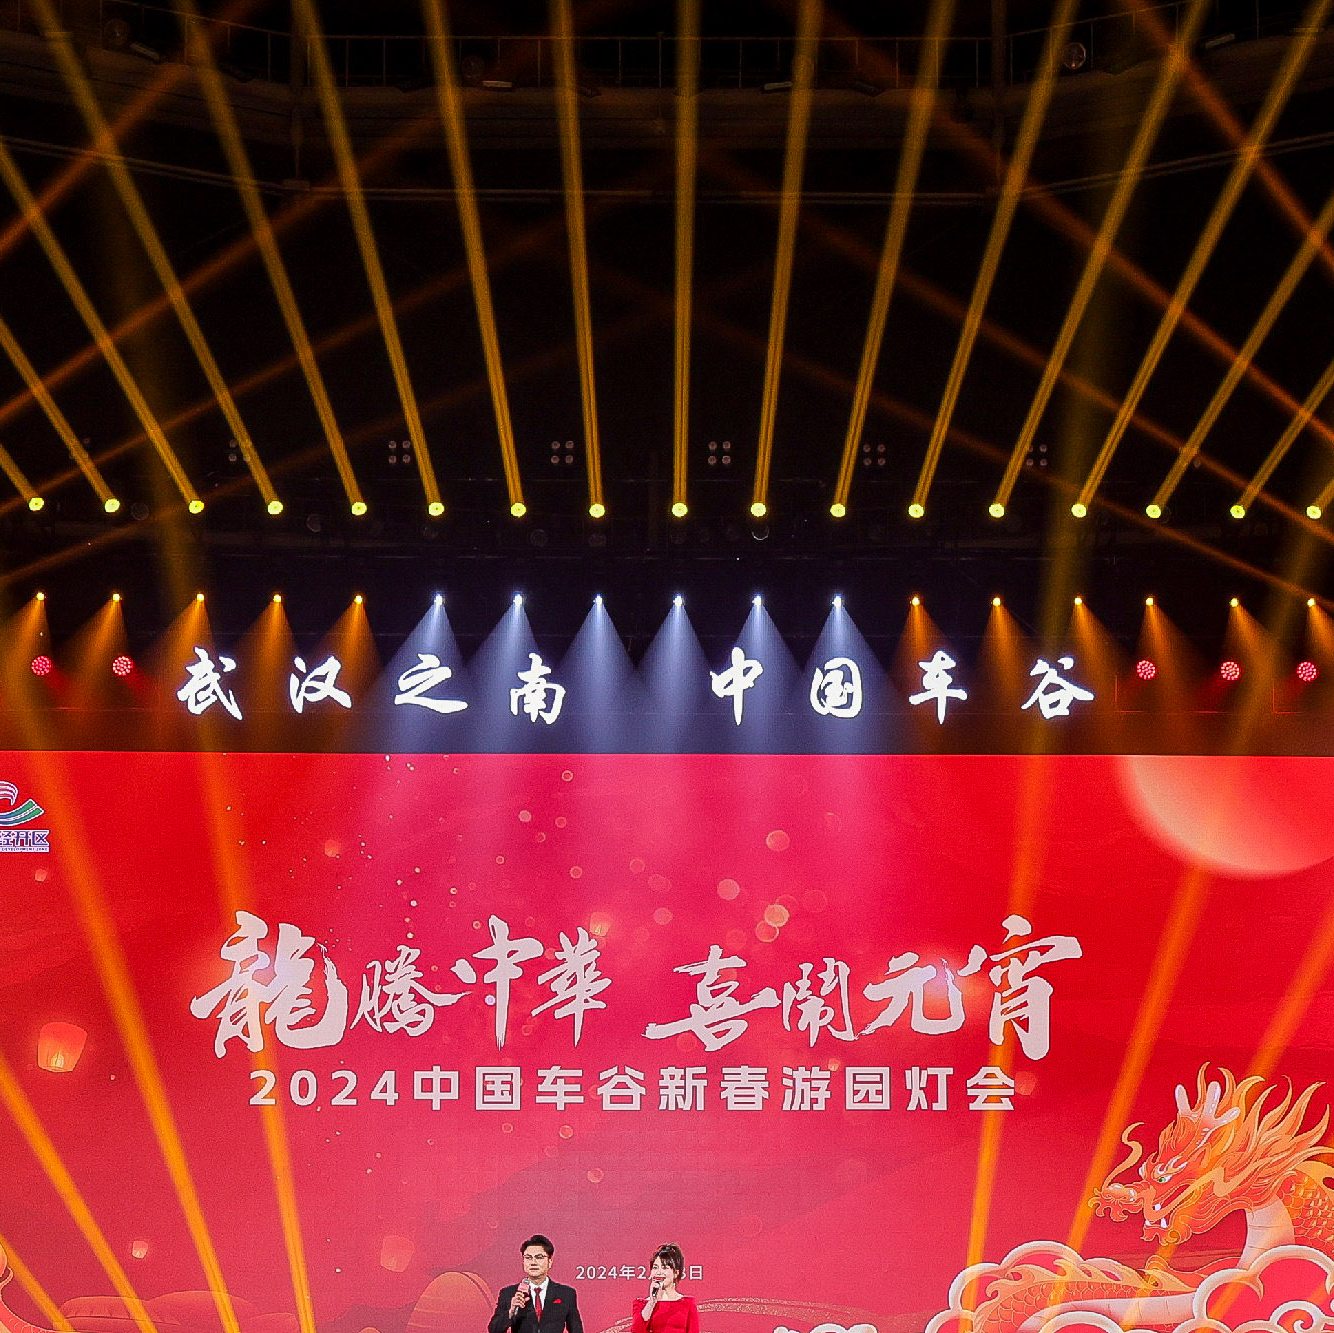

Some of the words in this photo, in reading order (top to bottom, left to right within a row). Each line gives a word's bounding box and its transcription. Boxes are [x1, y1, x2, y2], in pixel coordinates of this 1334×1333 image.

[176, 646, 567, 725] 武汉之南
[710, 646, 1095, 726] 中国车谷
[249, 1065, 1016, 1112] 2024中国车谷新春游园灯会
